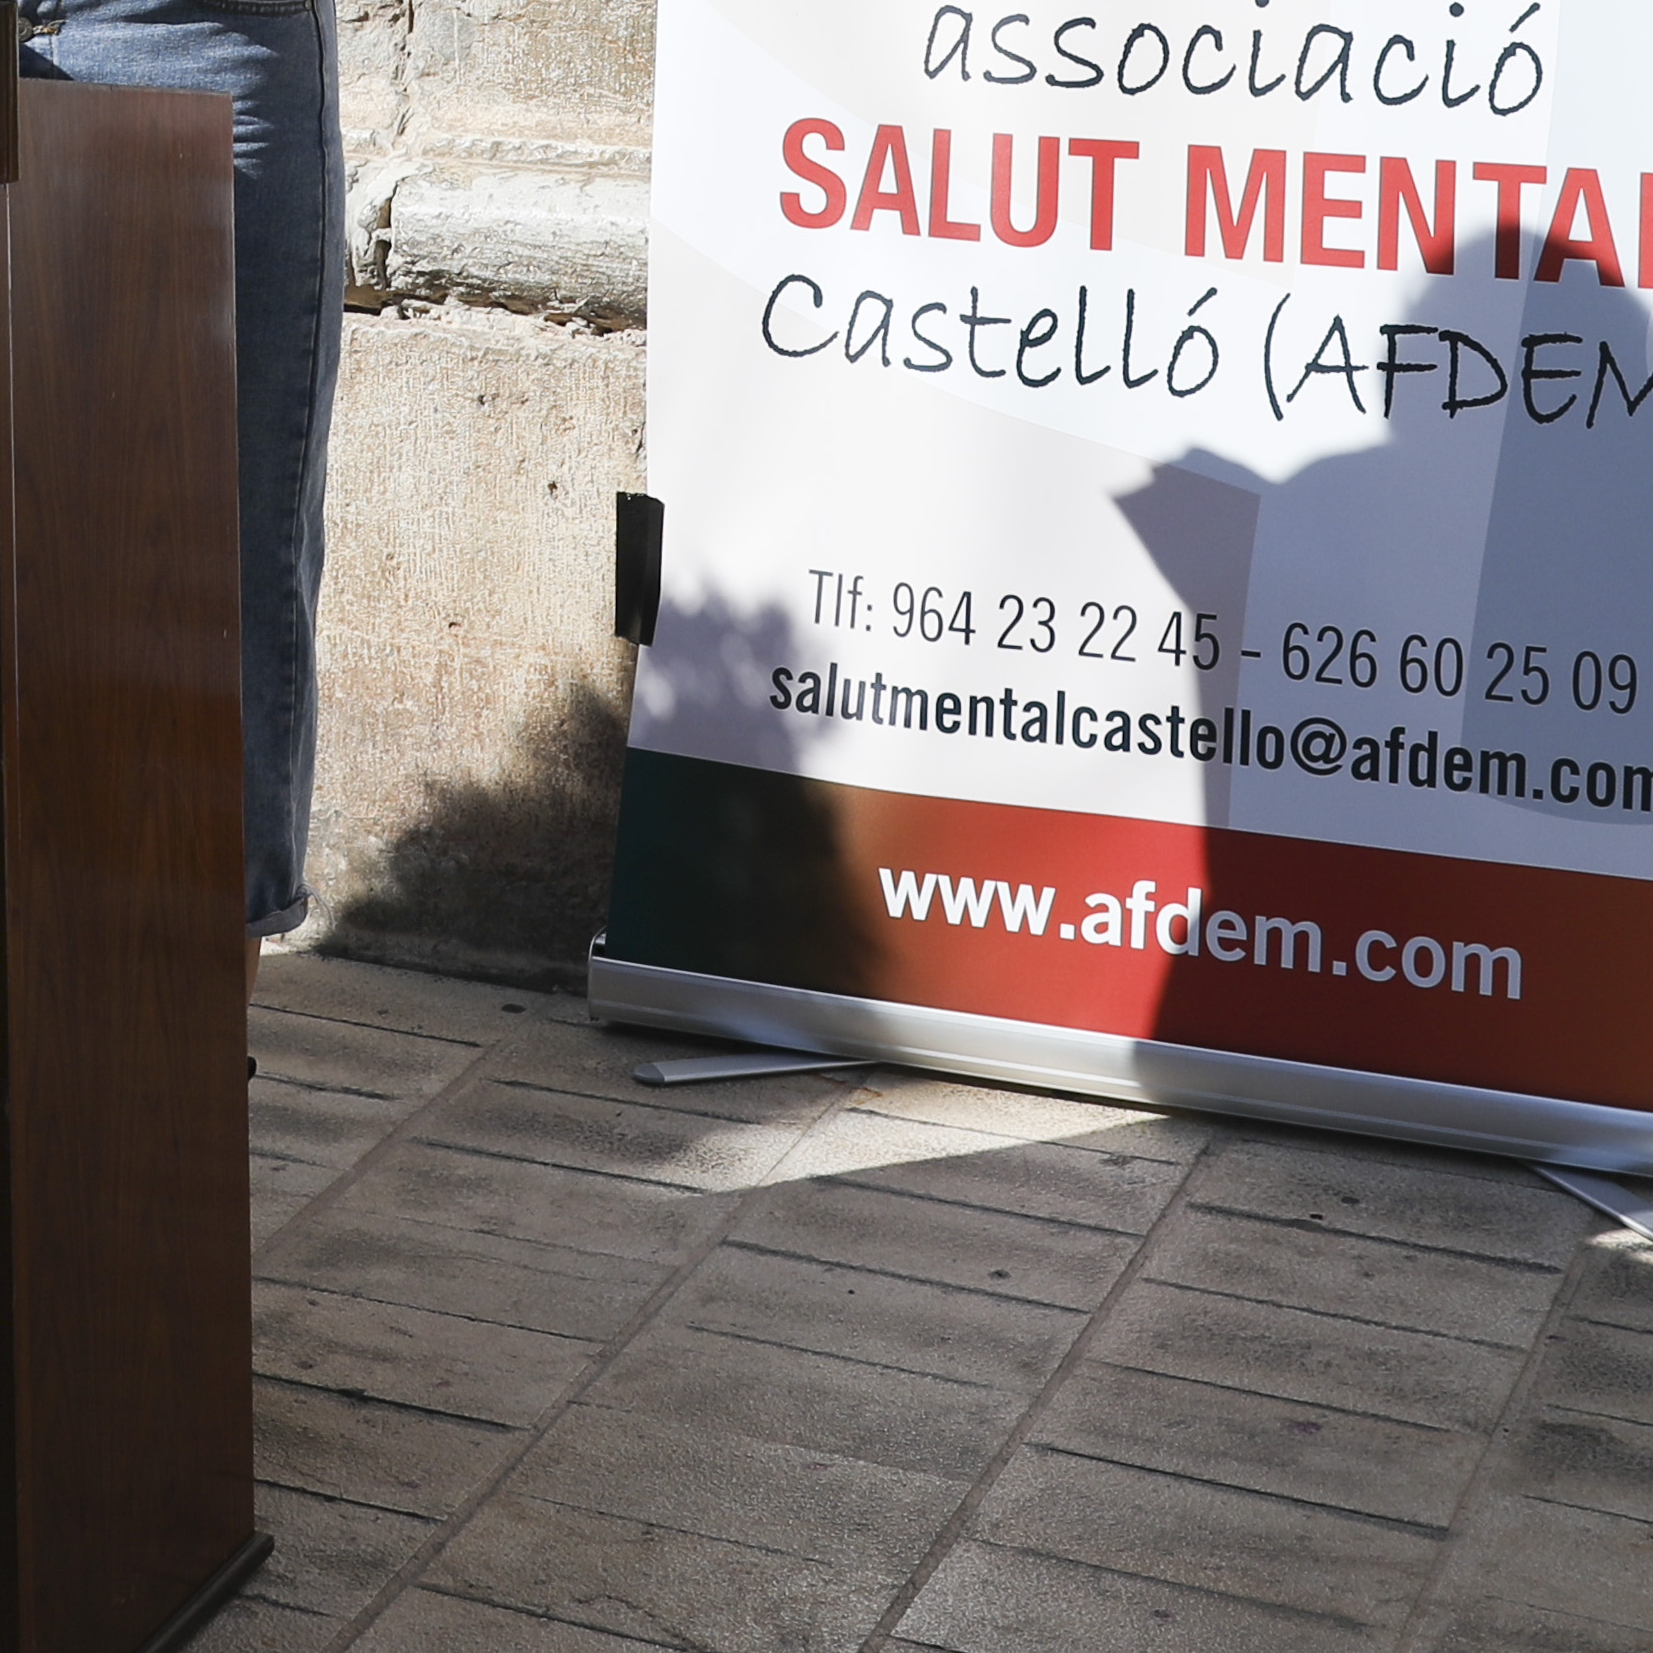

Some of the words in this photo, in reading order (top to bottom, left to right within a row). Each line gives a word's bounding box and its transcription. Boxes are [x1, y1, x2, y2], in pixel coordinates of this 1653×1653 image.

[779, 117, 1139, 252] SALUT
[761, 273, 1219, 399] Castelló
[808, 568, 874, 634] Tlf:
[891, 582, 977, 646] 964
[998, 592, 1058, 654] 23
[1078, 601, 1137, 663] 22
[1158, 609, 1221, 671] 45
[1281, 620, 1378, 689] 626
[1400, 633, 1464, 697] 60
[1485, 641, 1550, 707] 25
[1572, 649, 1639, 715] 09
[878, 866, 1525, 1000] www.afdem.com
